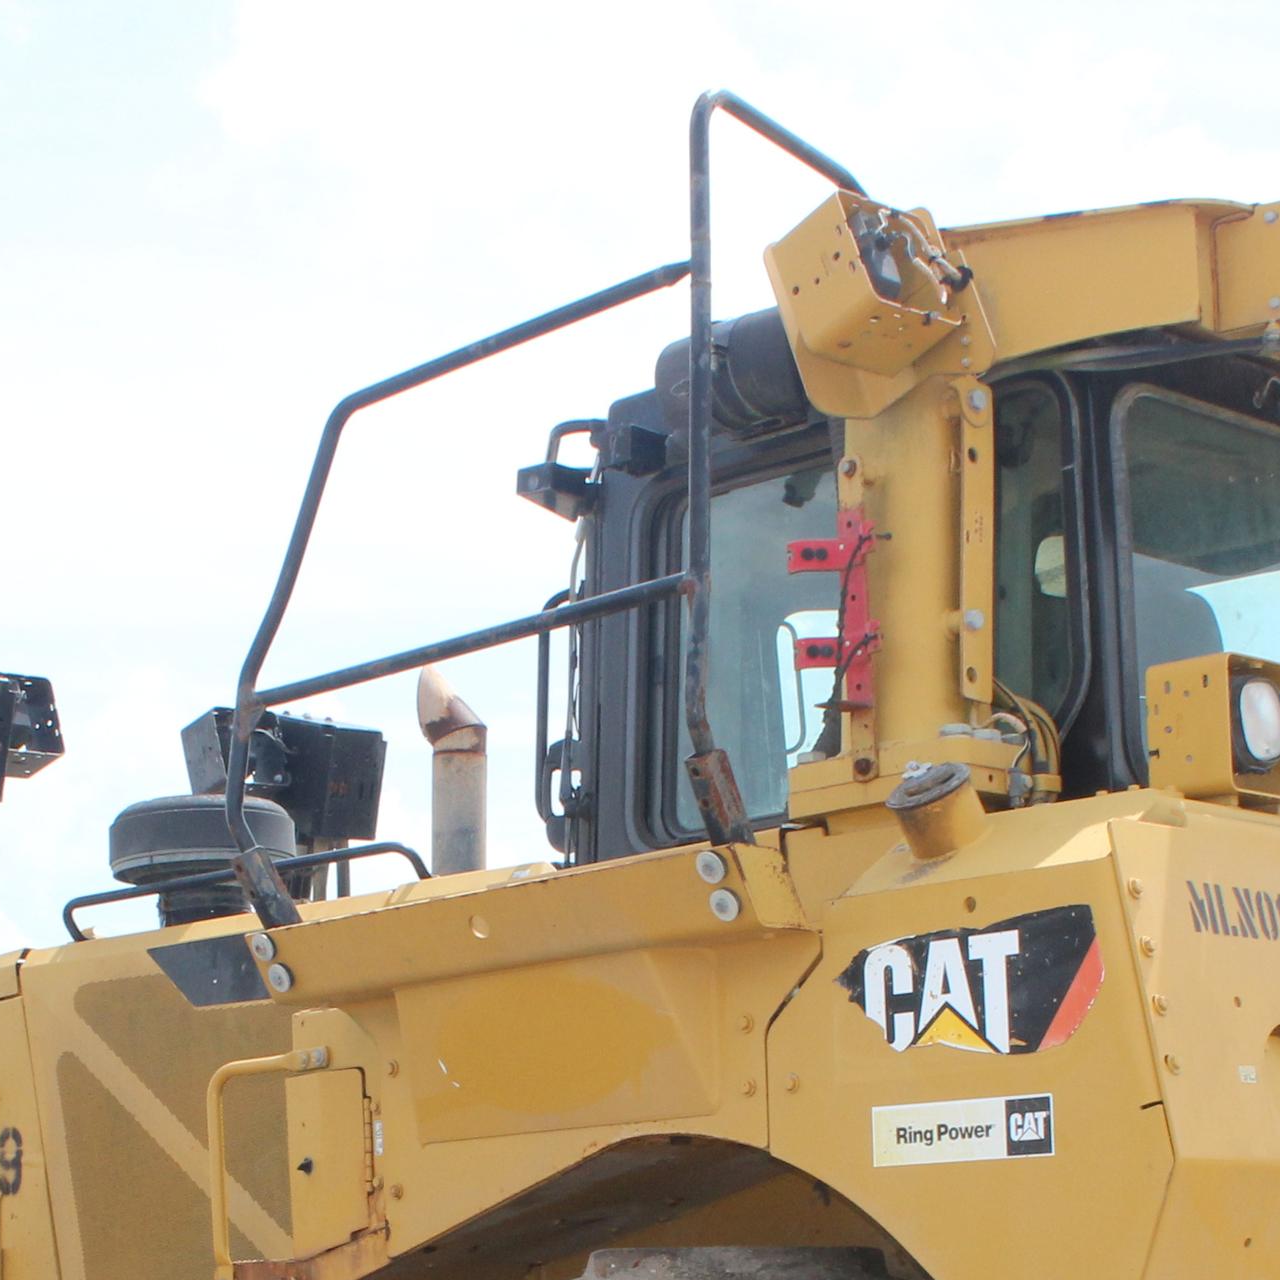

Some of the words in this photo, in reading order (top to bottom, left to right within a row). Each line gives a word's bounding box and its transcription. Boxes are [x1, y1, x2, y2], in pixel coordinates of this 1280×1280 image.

[863, 929, 1020, 1054] CAT
[896, 1126, 934, 1146] Ring
[936, 1123, 993, 1142] Power
[1009, 1110, 1048, 1142] CAT
